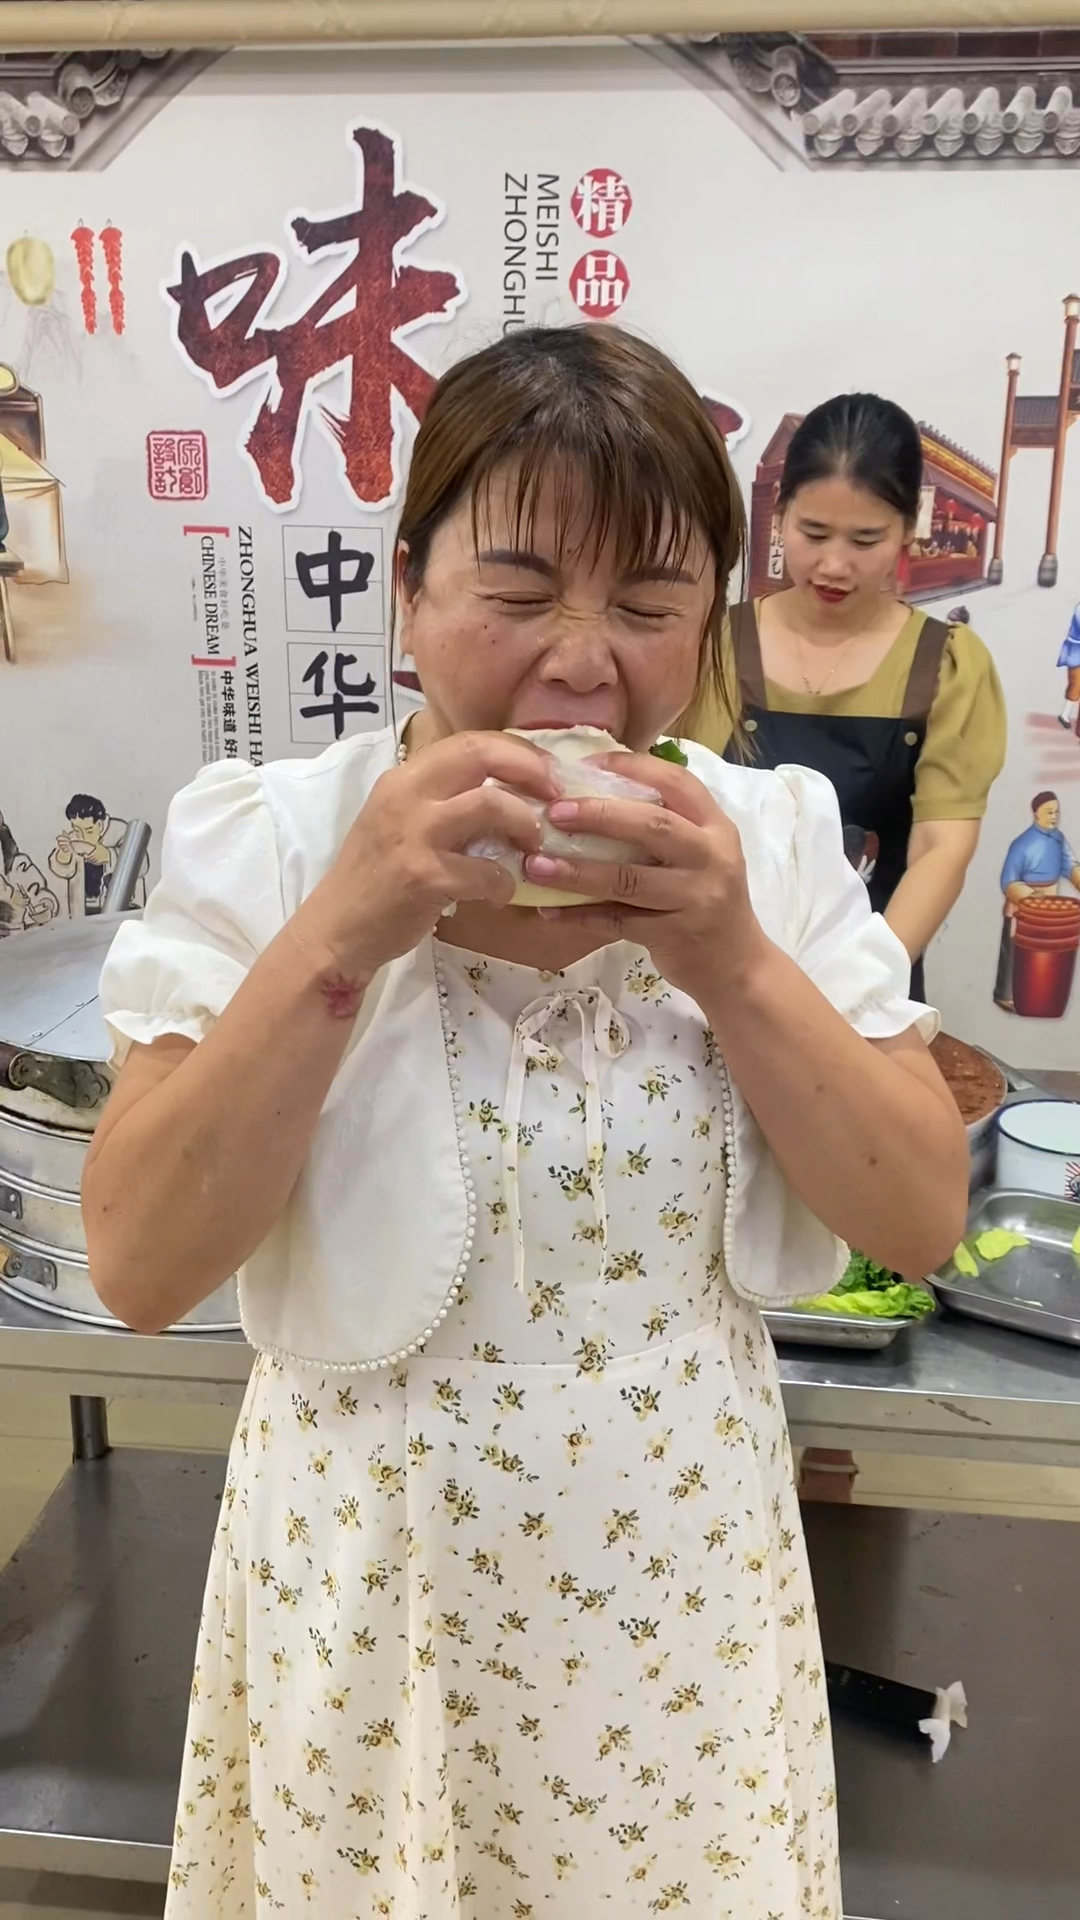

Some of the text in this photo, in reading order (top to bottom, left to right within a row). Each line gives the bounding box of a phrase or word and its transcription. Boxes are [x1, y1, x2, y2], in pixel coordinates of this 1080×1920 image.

[536, 174, 560, 280] MEISHI
[575, 175, 628, 307] 精品
[166, 127, 461, 504] 味
[201, 535, 217, 599] CHINESE
[238, 526, 258, 656] ZHONGHUA
[205, 603, 220, 655] DREAM
[295, 531, 379, 740] 中华
[221, 671, 237, 733] 中华味道
[246, 662, 262, 735] WEISHI
